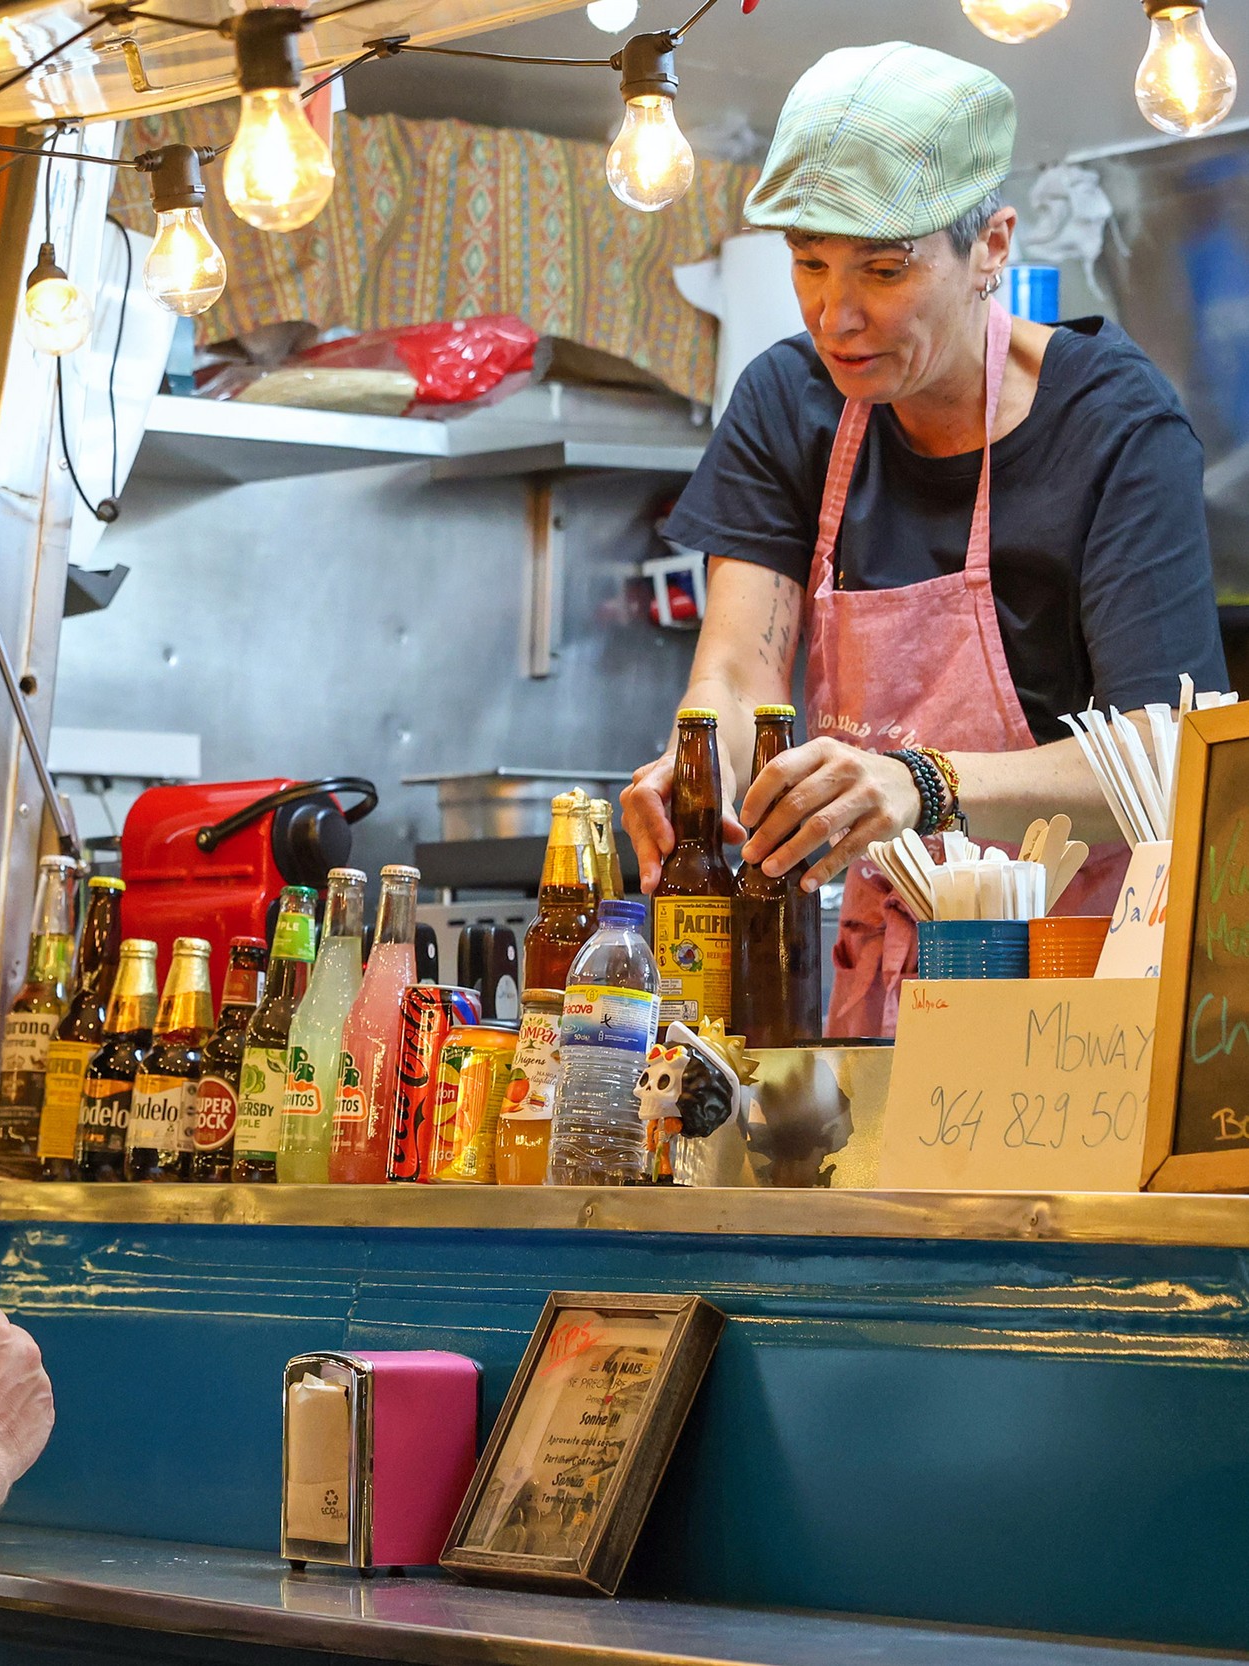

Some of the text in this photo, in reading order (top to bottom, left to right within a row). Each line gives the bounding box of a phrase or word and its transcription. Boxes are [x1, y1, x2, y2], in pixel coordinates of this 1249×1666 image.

[79, 1098, 129, 1130] odelo
[135, 1096, 178, 1123] odelo
[918, 1085, 985, 1152] 964
[1002, 1090, 1071, 1150] 829
[194, 1113, 228, 1130] OCK
[578, 1411, 608, 1426] Sonhe
[321, 1507, 336, 1515] ECO
